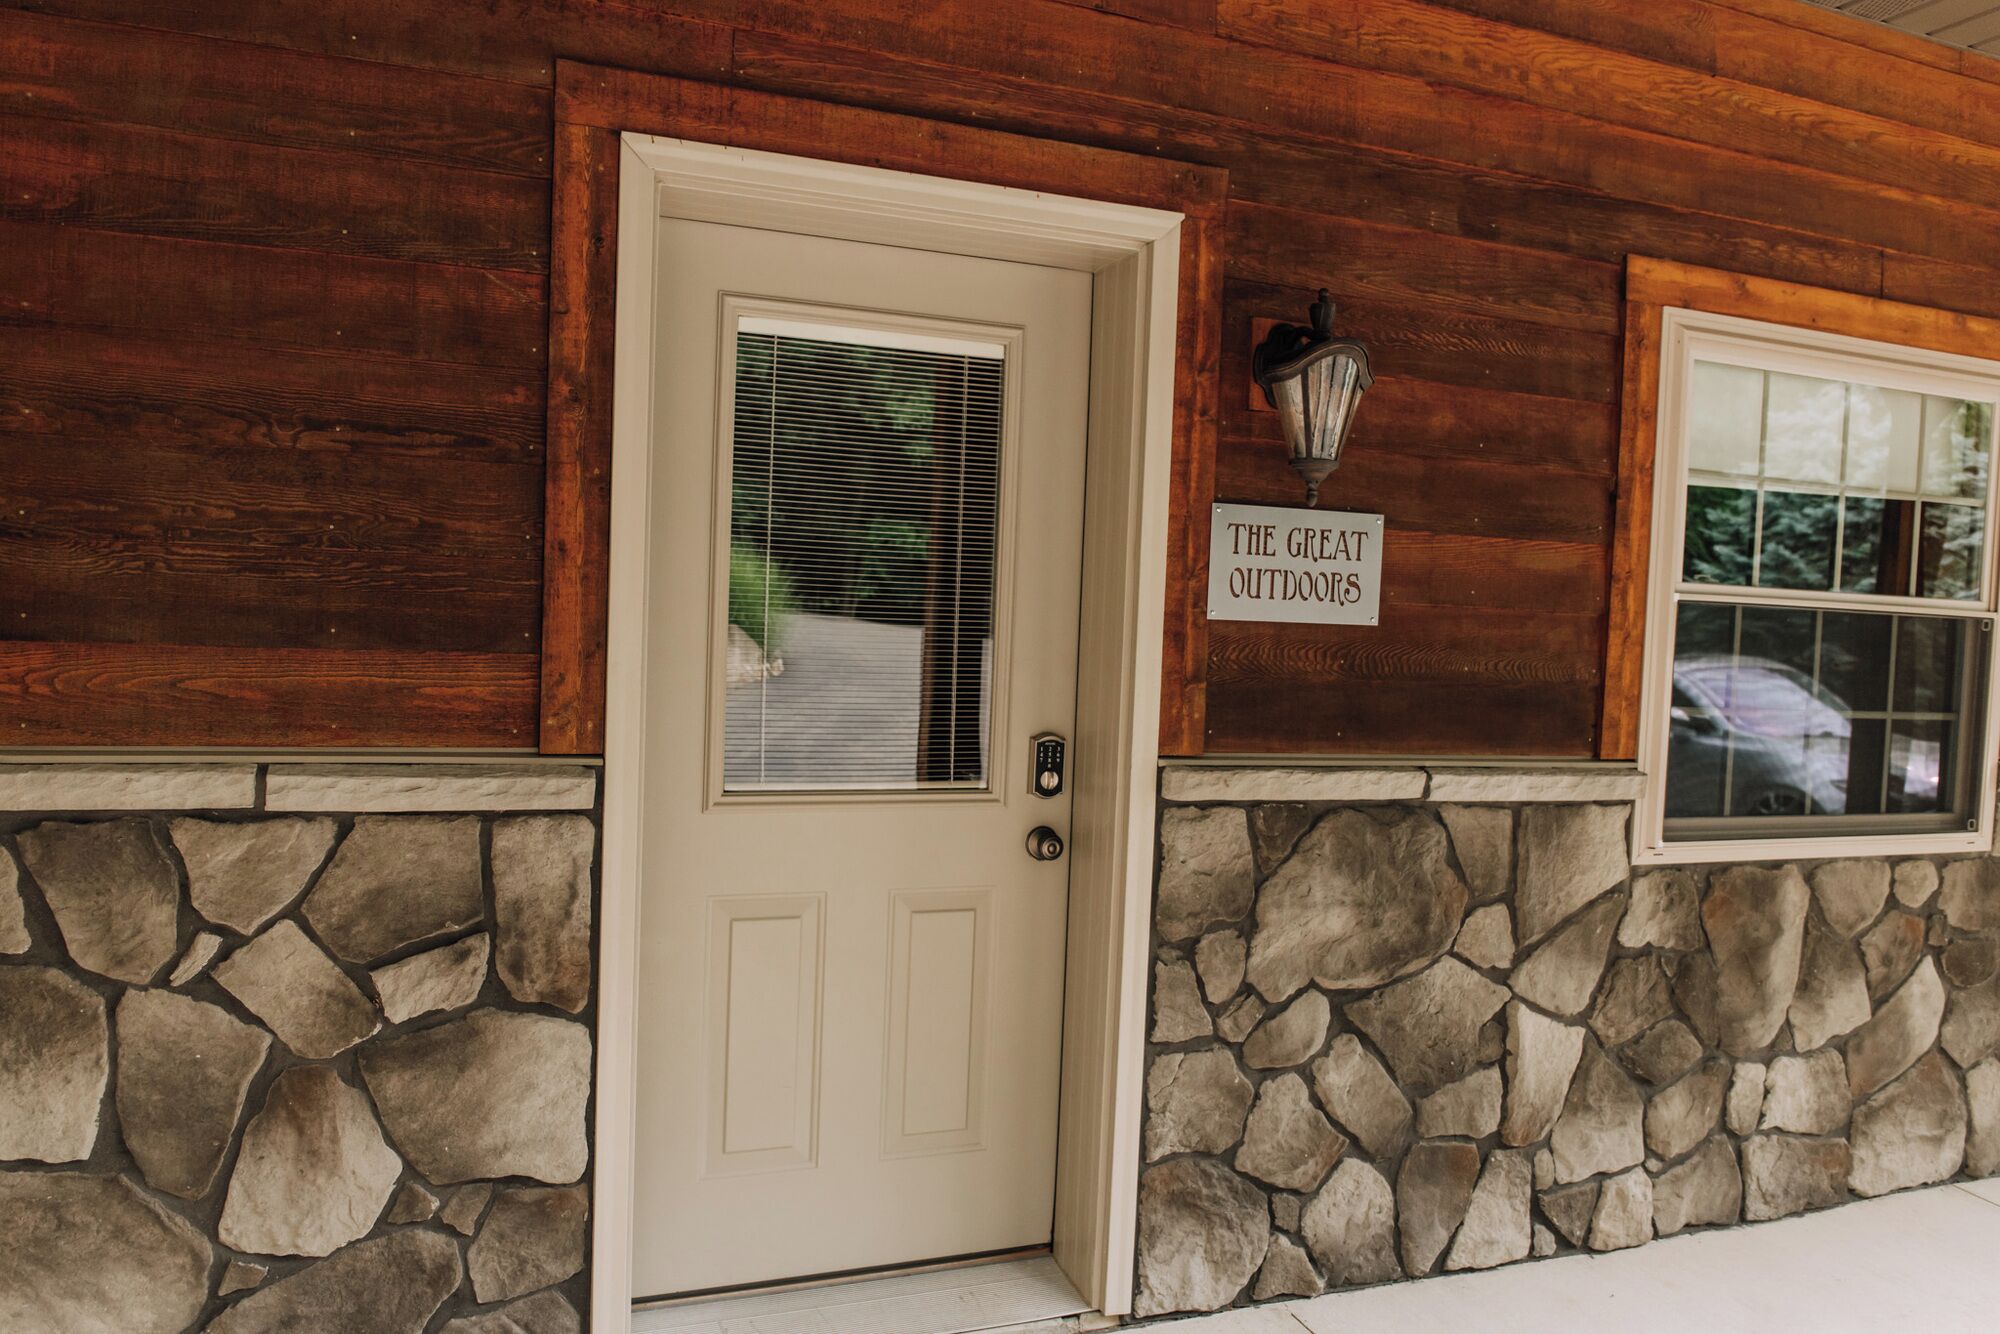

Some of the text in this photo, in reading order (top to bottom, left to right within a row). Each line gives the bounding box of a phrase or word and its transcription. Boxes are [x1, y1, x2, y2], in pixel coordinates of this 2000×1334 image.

[1227, 523, 1369, 562] THE GREAT
[1229, 567, 1361, 606] OUTDOORS
